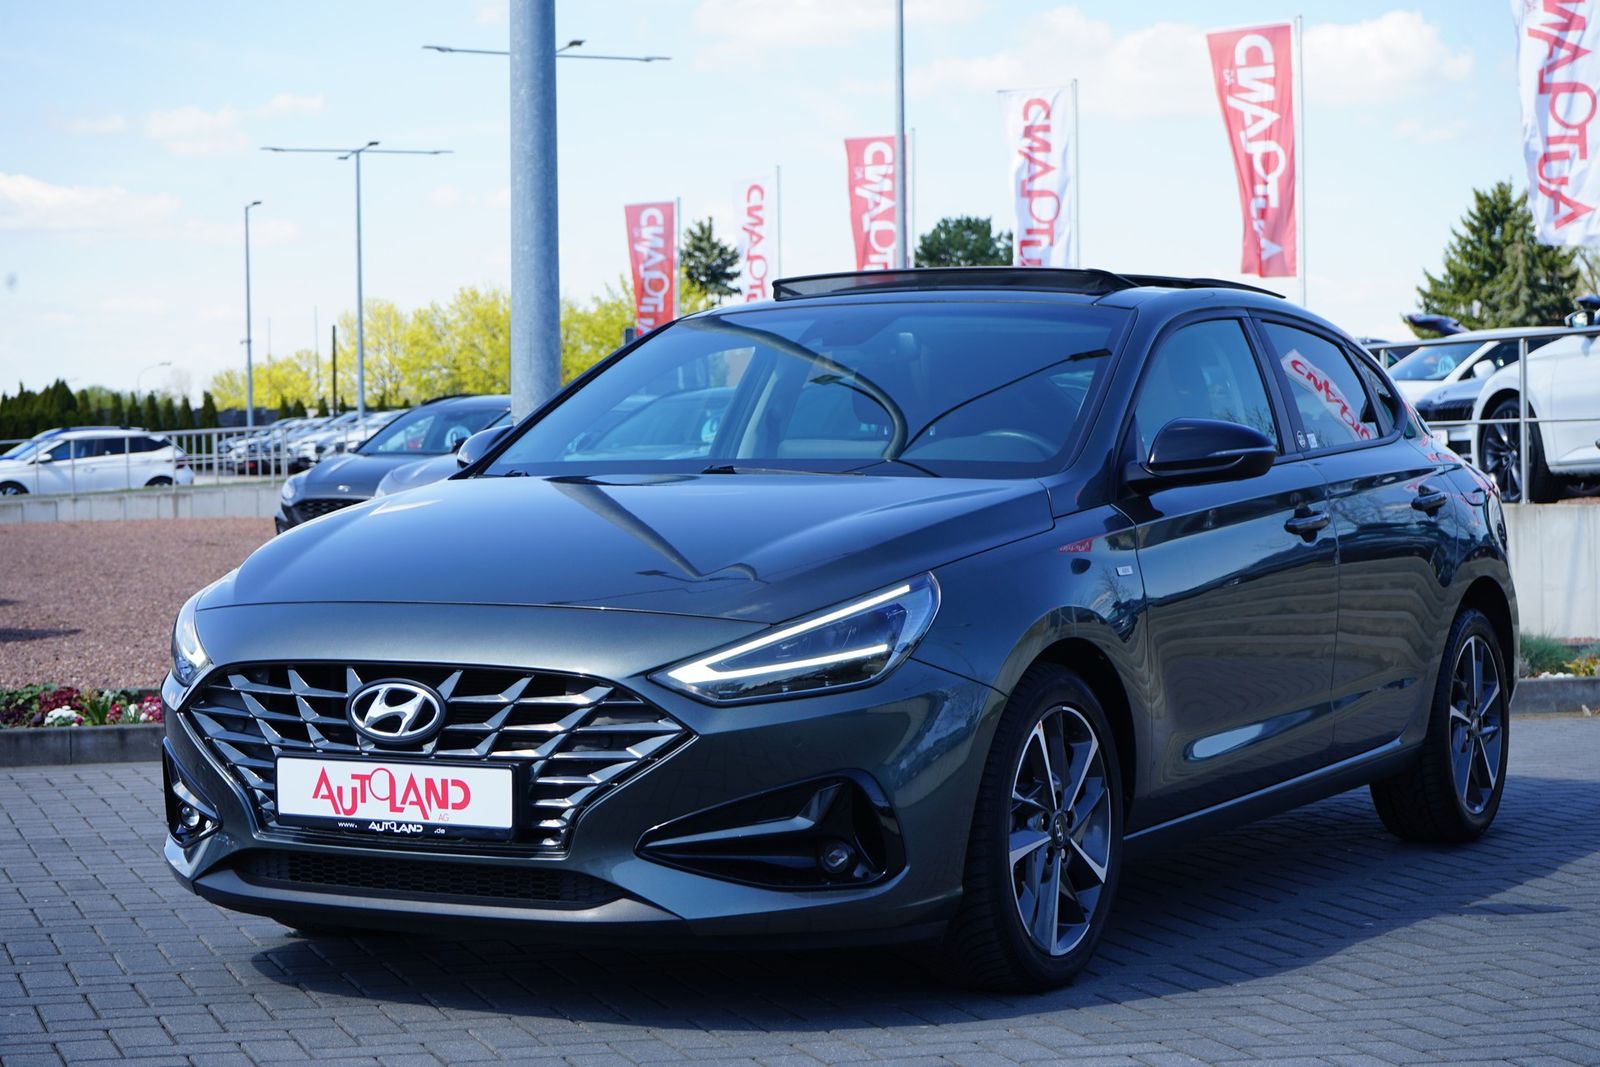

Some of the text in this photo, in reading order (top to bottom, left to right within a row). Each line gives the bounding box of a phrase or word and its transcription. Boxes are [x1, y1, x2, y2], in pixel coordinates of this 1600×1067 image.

[312, 766, 471, 821] AUTOLAND
[438, 813, 449, 822] AG
[338, 821, 358, 829] www.
[368, 821, 423, 834] AUTOLAND
